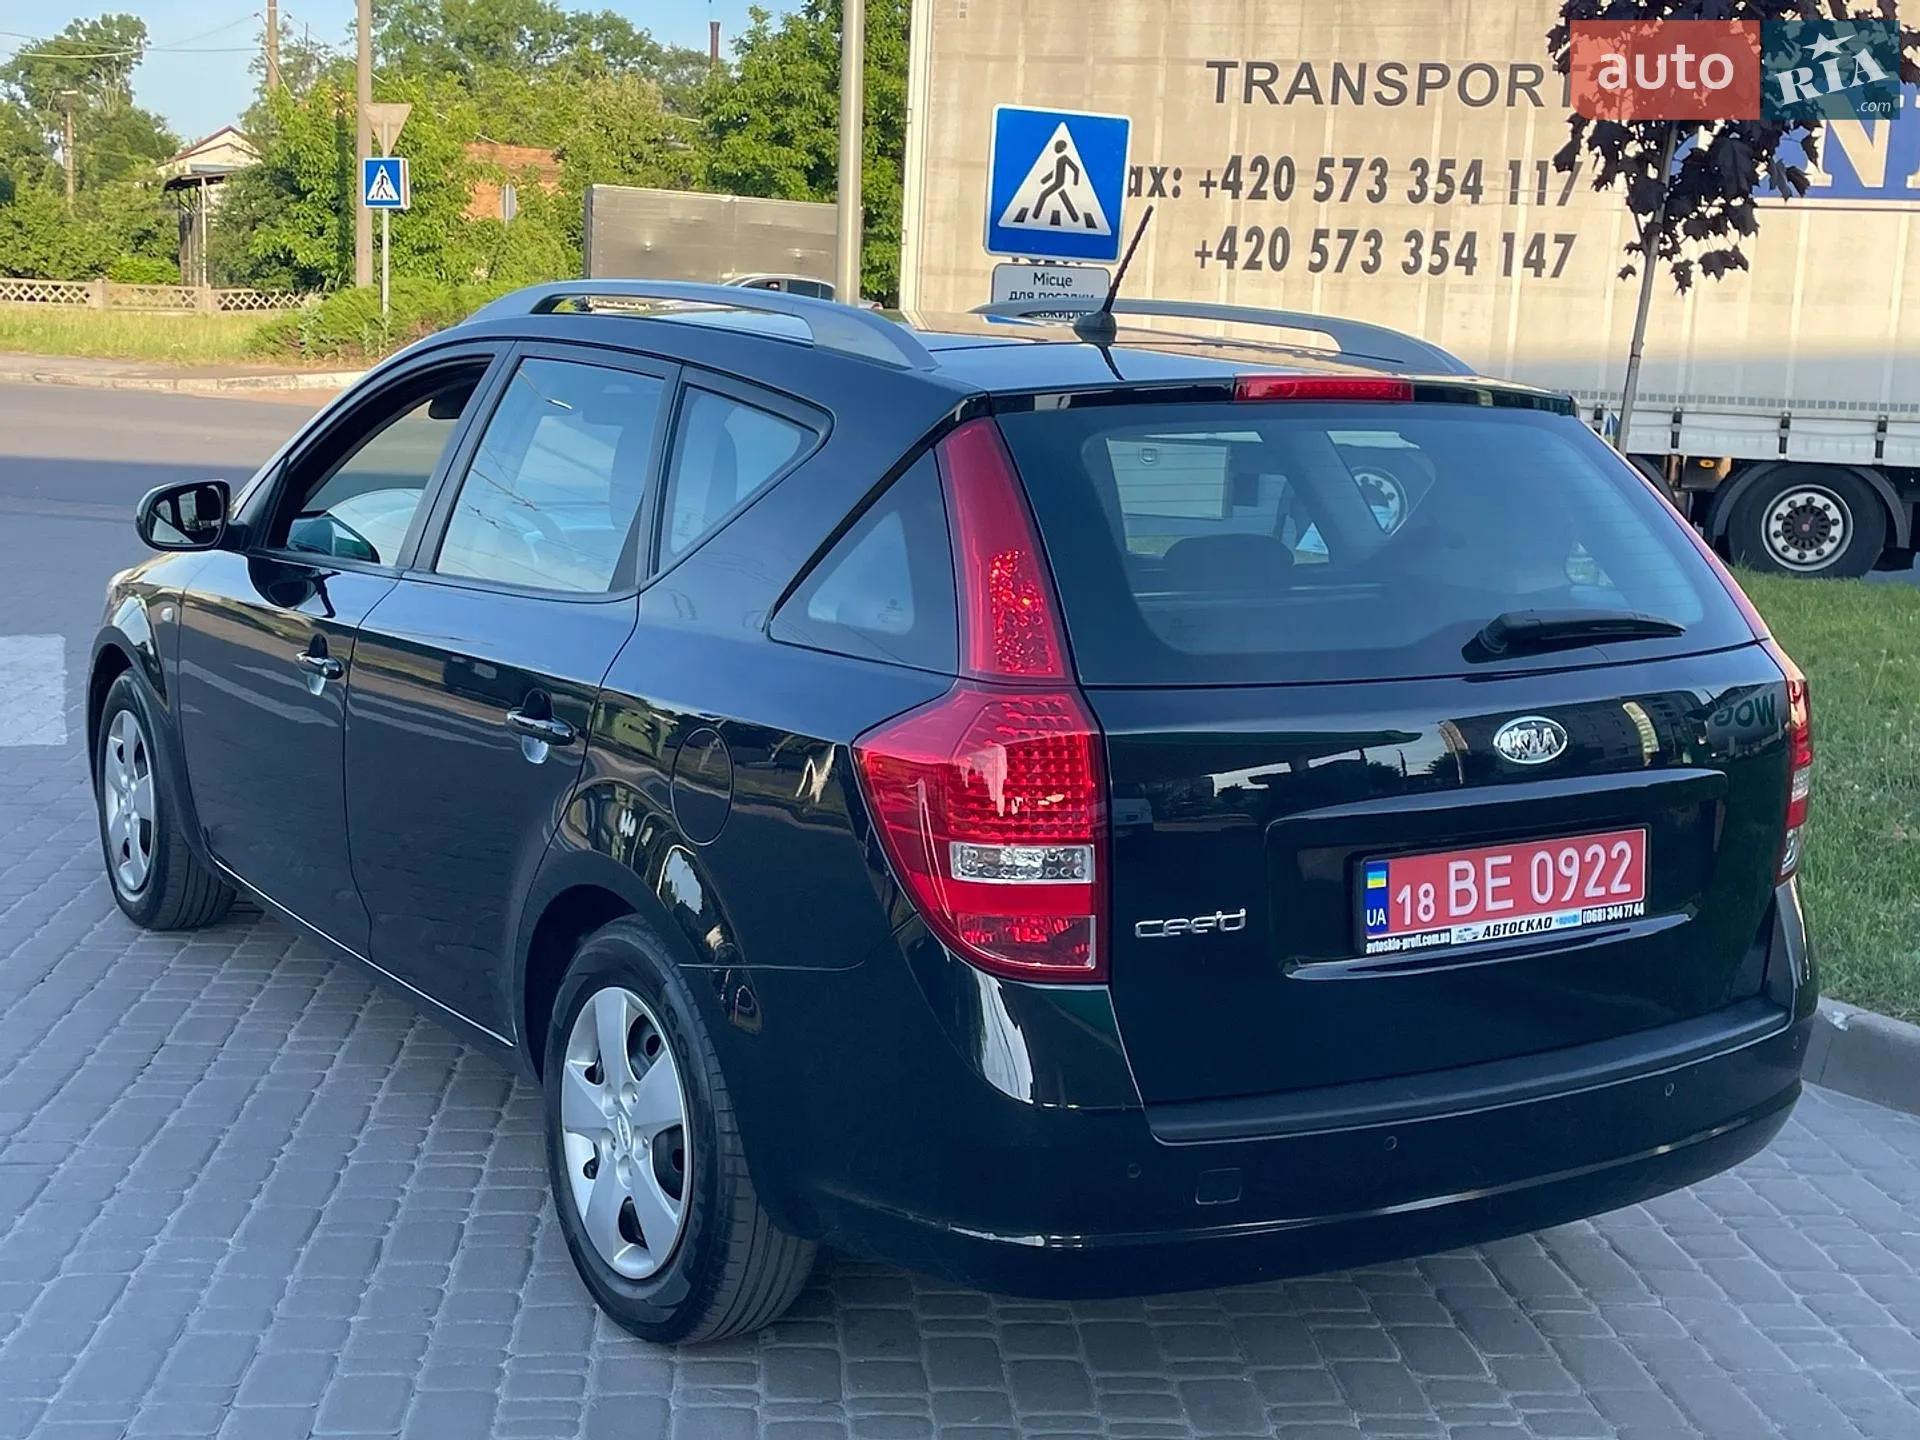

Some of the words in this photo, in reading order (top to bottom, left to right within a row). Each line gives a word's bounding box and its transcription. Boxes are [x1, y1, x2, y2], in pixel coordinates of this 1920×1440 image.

[1127, 166, 1182, 198] ax:
[1199, 155, 1294, 203] +420
[1313, 157, 1389, 204] 573
[1407, 159, 1483, 206] 354
[1506, 160, 1582, 207] 117
[1194, 226, 1291, 272] +420
[1308, 228, 1383, 275] 573
[1401, 230, 1477, 277] 354
[1502, 232, 1577, 279] 147
[1008, 291, 1035, 301] для
[1033, 272, 1073, 288] Місце
[1396, 882, 1436, 925] 18
[1449, 854, 1514, 917] BE
[1530, 840, 1632, 904] 0922
[1366, 908, 1387, 927] UA
